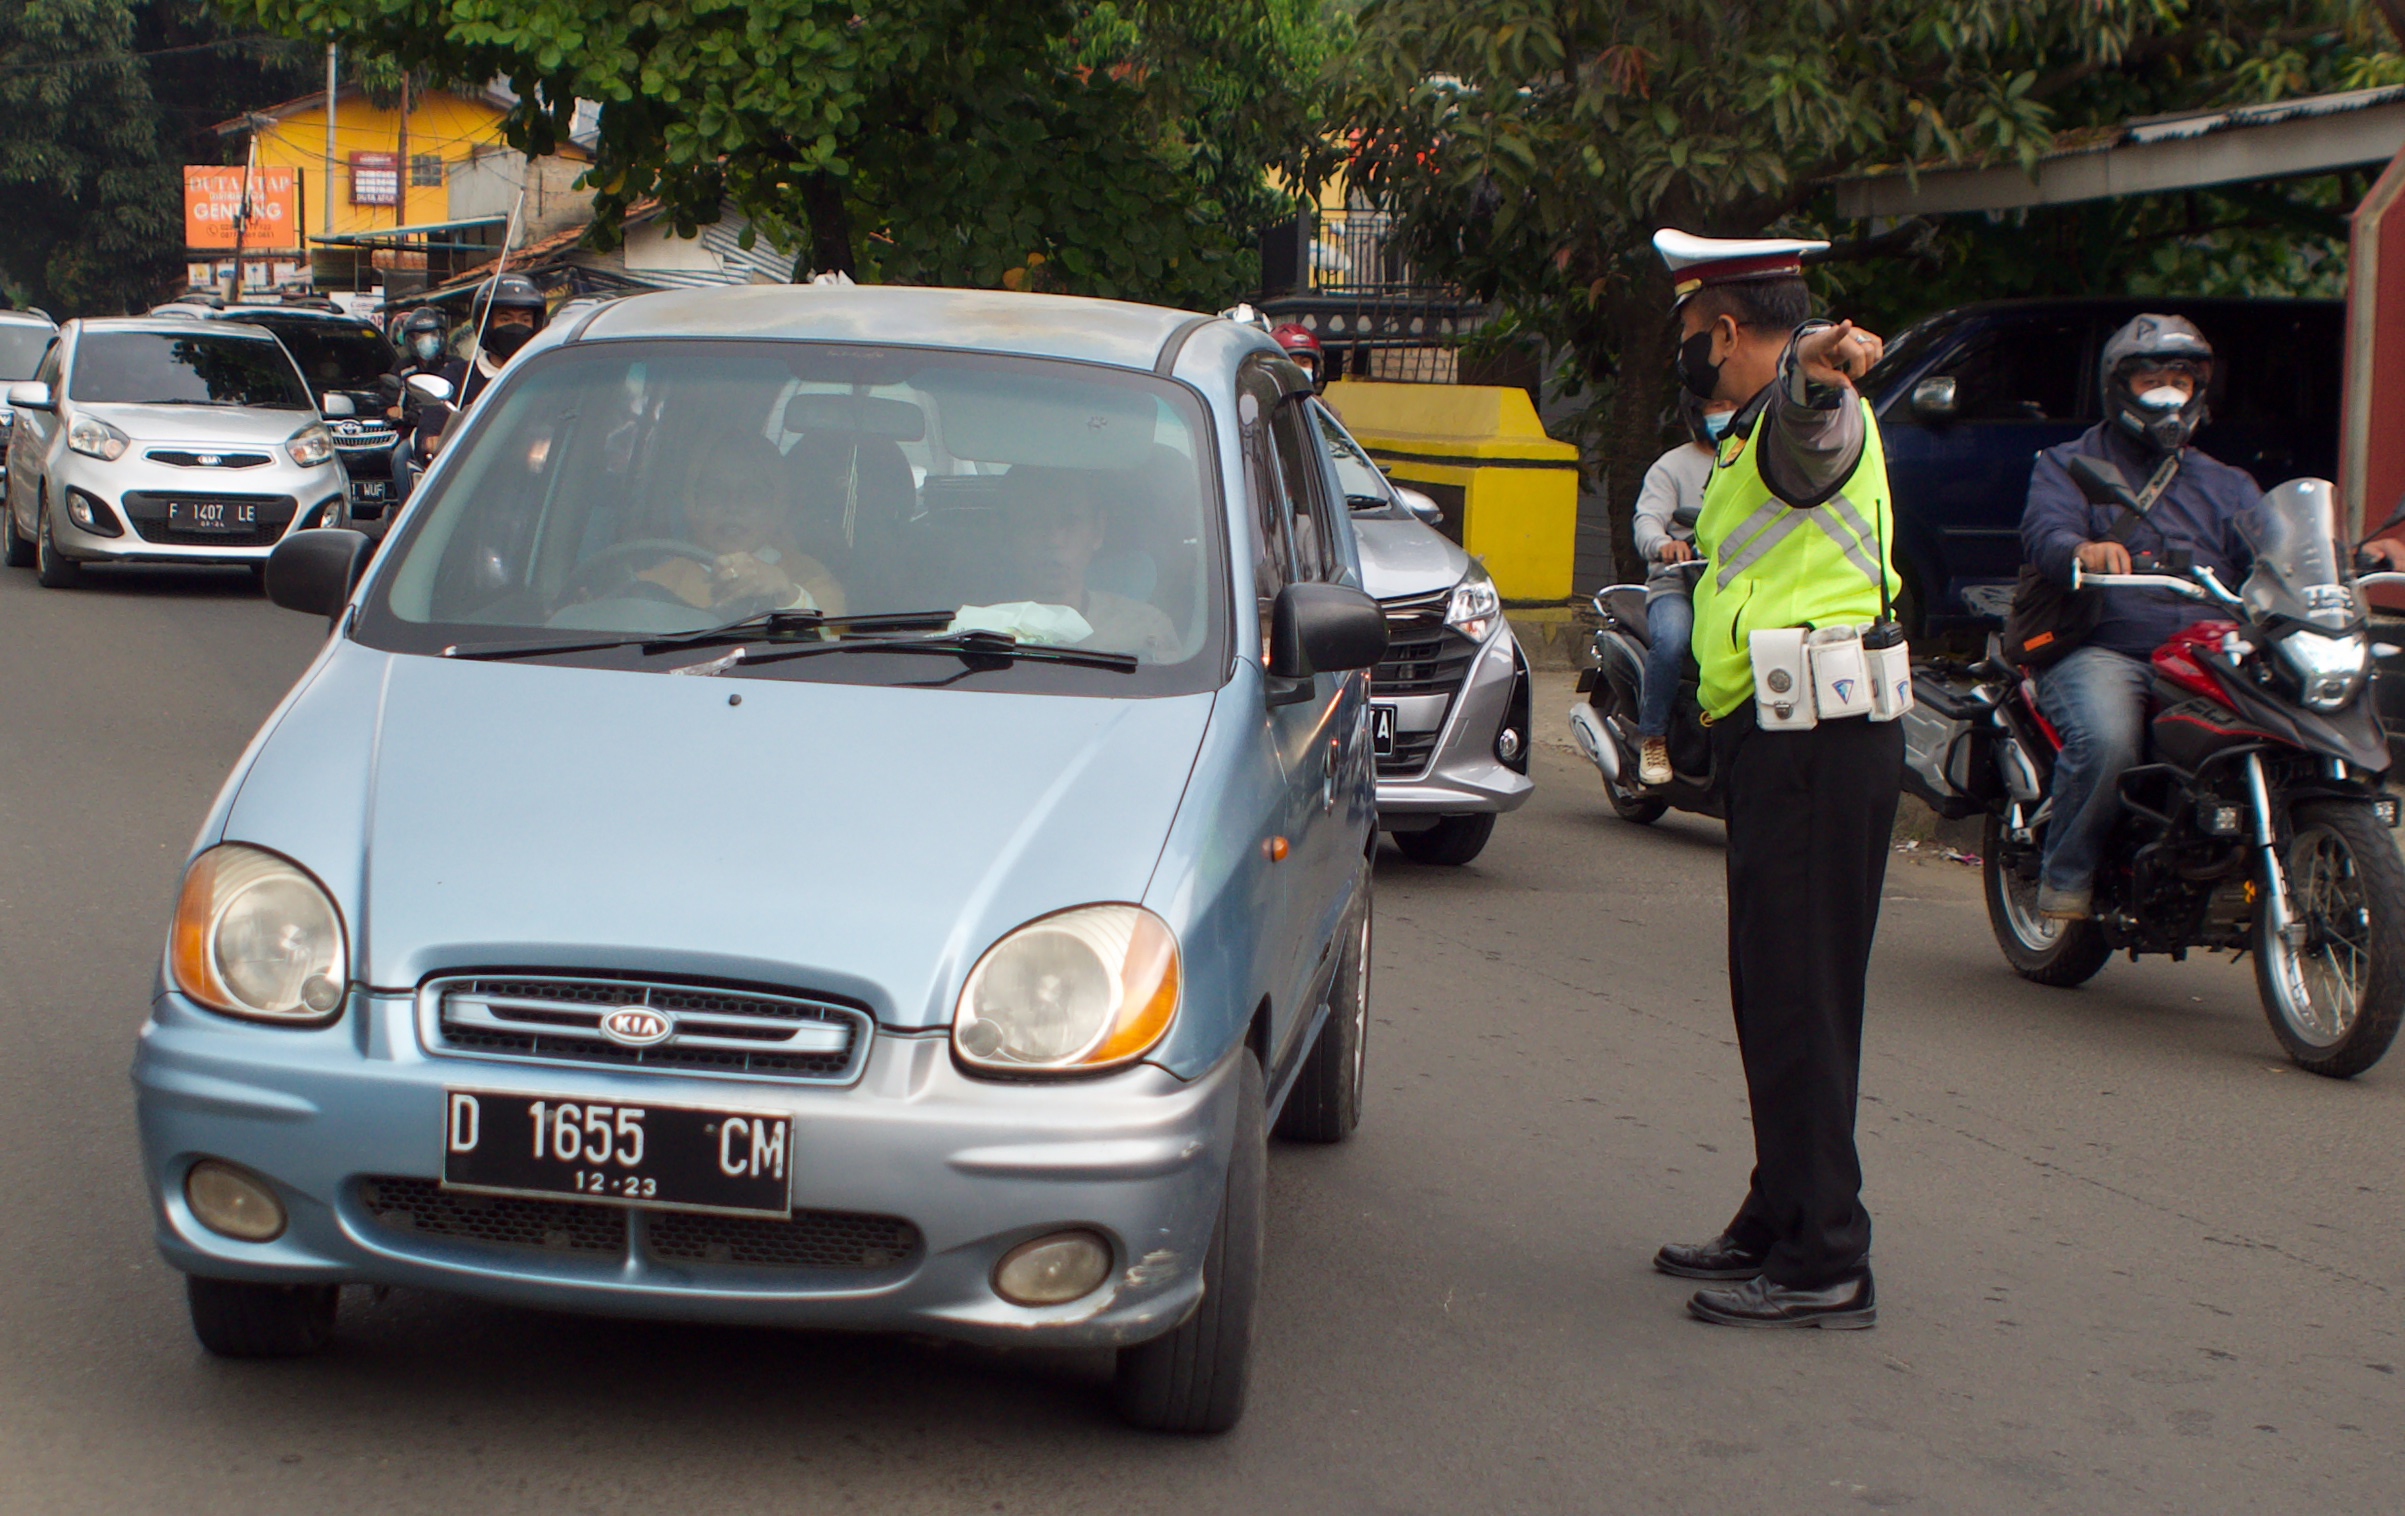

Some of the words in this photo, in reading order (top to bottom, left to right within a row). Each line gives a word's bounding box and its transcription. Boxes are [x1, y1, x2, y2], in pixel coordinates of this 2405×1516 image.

[189, 176, 239, 192] DUTA
[169, 503, 178, 519] F
[194, 504, 224, 520] 1407
[238, 505, 255, 522] LE
[615, 1015, 659, 1035] KIA
[452, 1093, 480, 1151] D
[529, 1101, 646, 1167] 1655
[720, 1116, 784, 1179] CM
